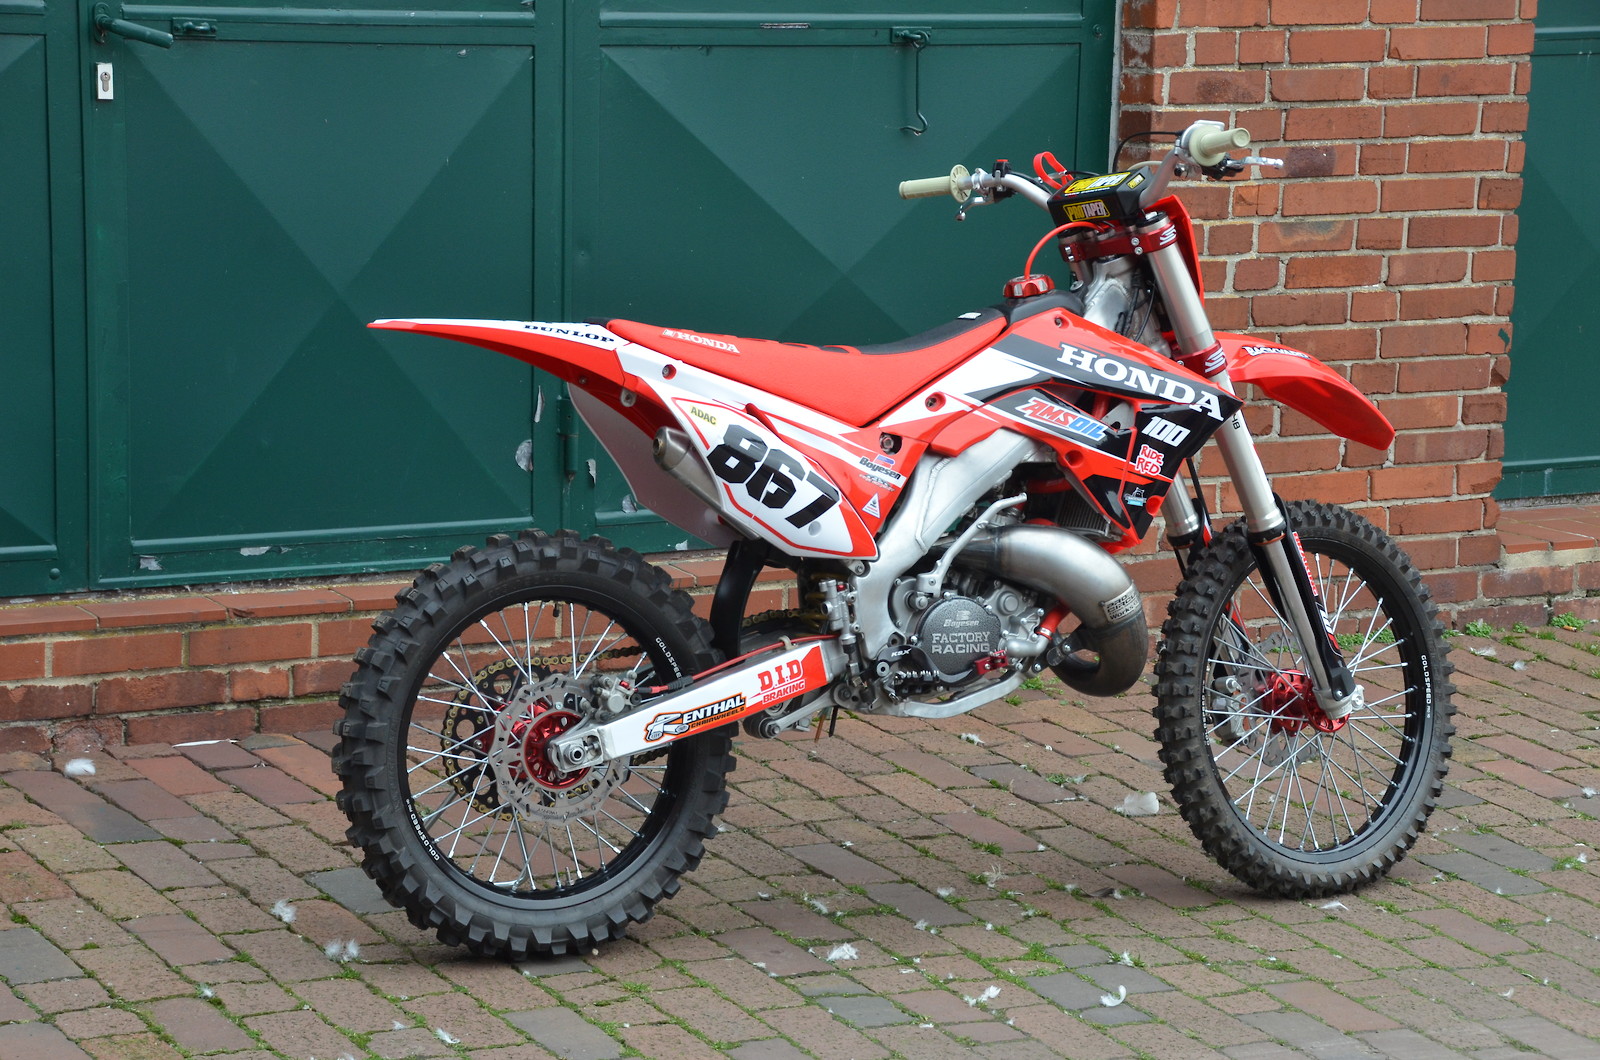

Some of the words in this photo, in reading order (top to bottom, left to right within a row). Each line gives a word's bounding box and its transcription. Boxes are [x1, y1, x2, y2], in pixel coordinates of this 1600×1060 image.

[524, 324, 615, 343] DUNLOP
[674, 329, 740, 354] HONDA
[1056, 343, 1225, 422] HONDA
[690, 406, 717, 426] ADAC
[1018, 398, 1106, 441] AMSOIL
[1141, 416, 1191, 447] 100
[1136, 457, 1161, 475] RED
[1140, 445, 1164, 466] RIDE
[706, 423, 841, 529] 867
[859, 456, 902, 480] Boyesen
[931, 631, 991, 644] FACTORY
[931, 642, 991, 655] RACING
[655, 637, 682, 679] GOLDSPEE
[757, 658, 804, 693] D.I.D
[1420, 654, 1432, 705] GOLDSPEED
[763, 681, 806, 704] BRAKING
